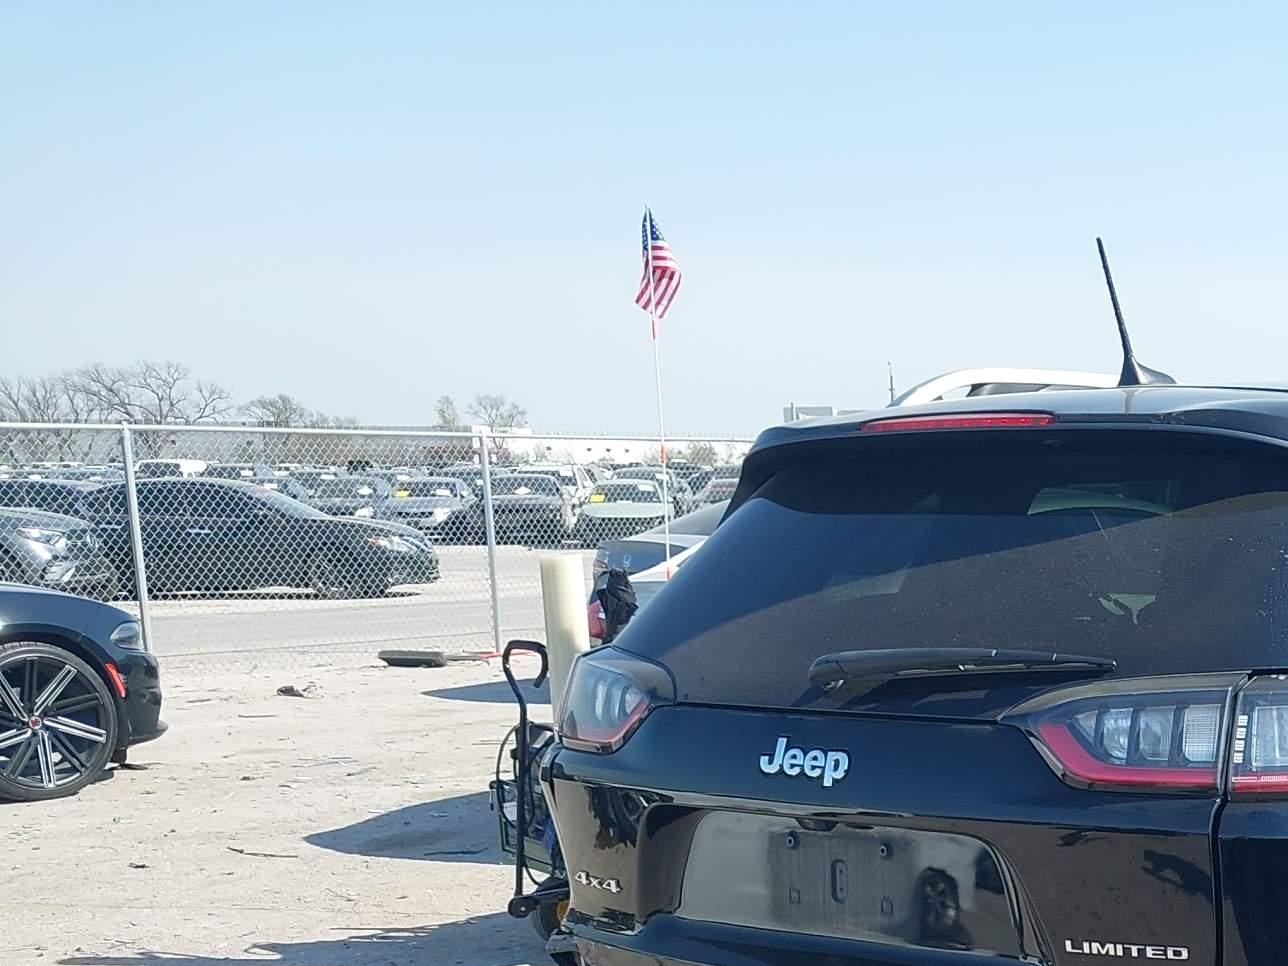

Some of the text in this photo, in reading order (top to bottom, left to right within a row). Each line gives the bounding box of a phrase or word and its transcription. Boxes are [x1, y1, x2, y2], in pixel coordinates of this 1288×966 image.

[760, 737, 849, 787] Jeep
[574, 871, 621, 893] 4x4
[1064, 939, 1189, 960] LIMITED
